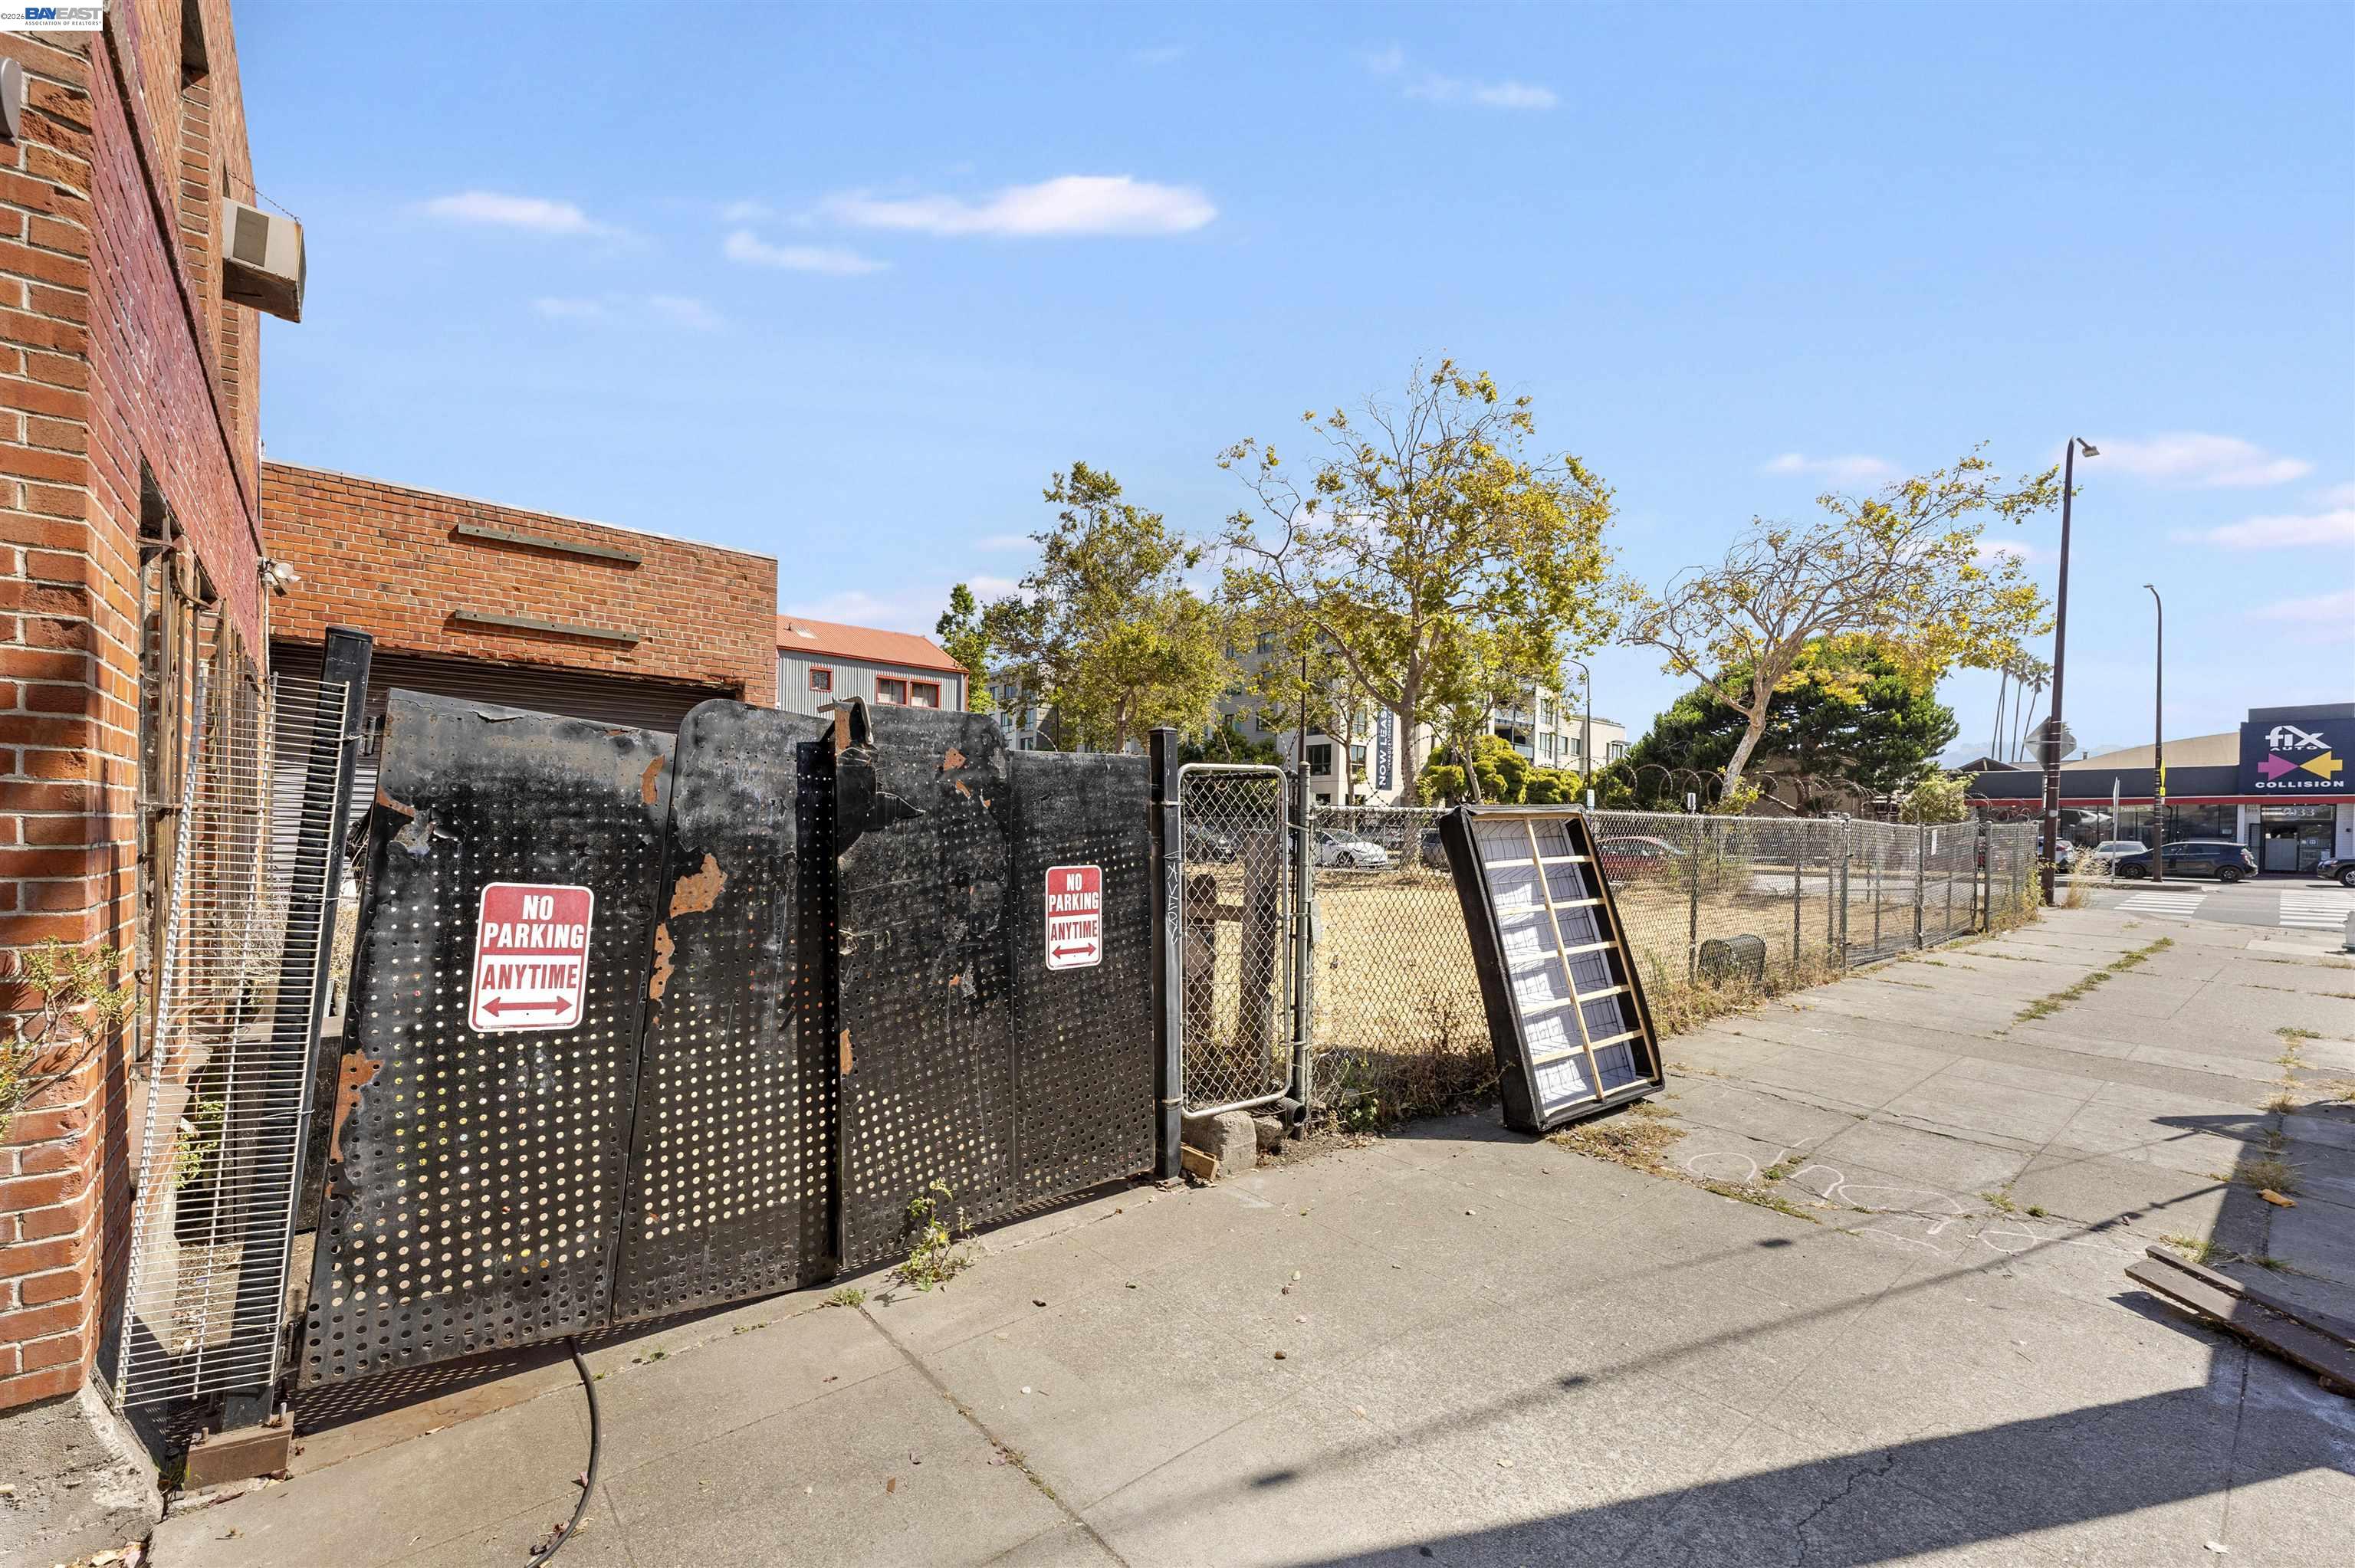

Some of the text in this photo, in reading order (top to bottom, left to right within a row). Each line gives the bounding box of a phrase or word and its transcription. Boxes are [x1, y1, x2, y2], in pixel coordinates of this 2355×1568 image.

[1378, 750, 1387, 786] NOW
[2255, 780, 2344, 789] COLLISION
[1066, 873, 1082, 891] NO
[522, 894, 554, 920] NO
[1049, 891, 1099, 912] PARKING
[483, 922, 585, 949] PARKING
[1050, 920, 1098, 941] ANYTIME
[481, 964, 579, 990] ANYTIME
